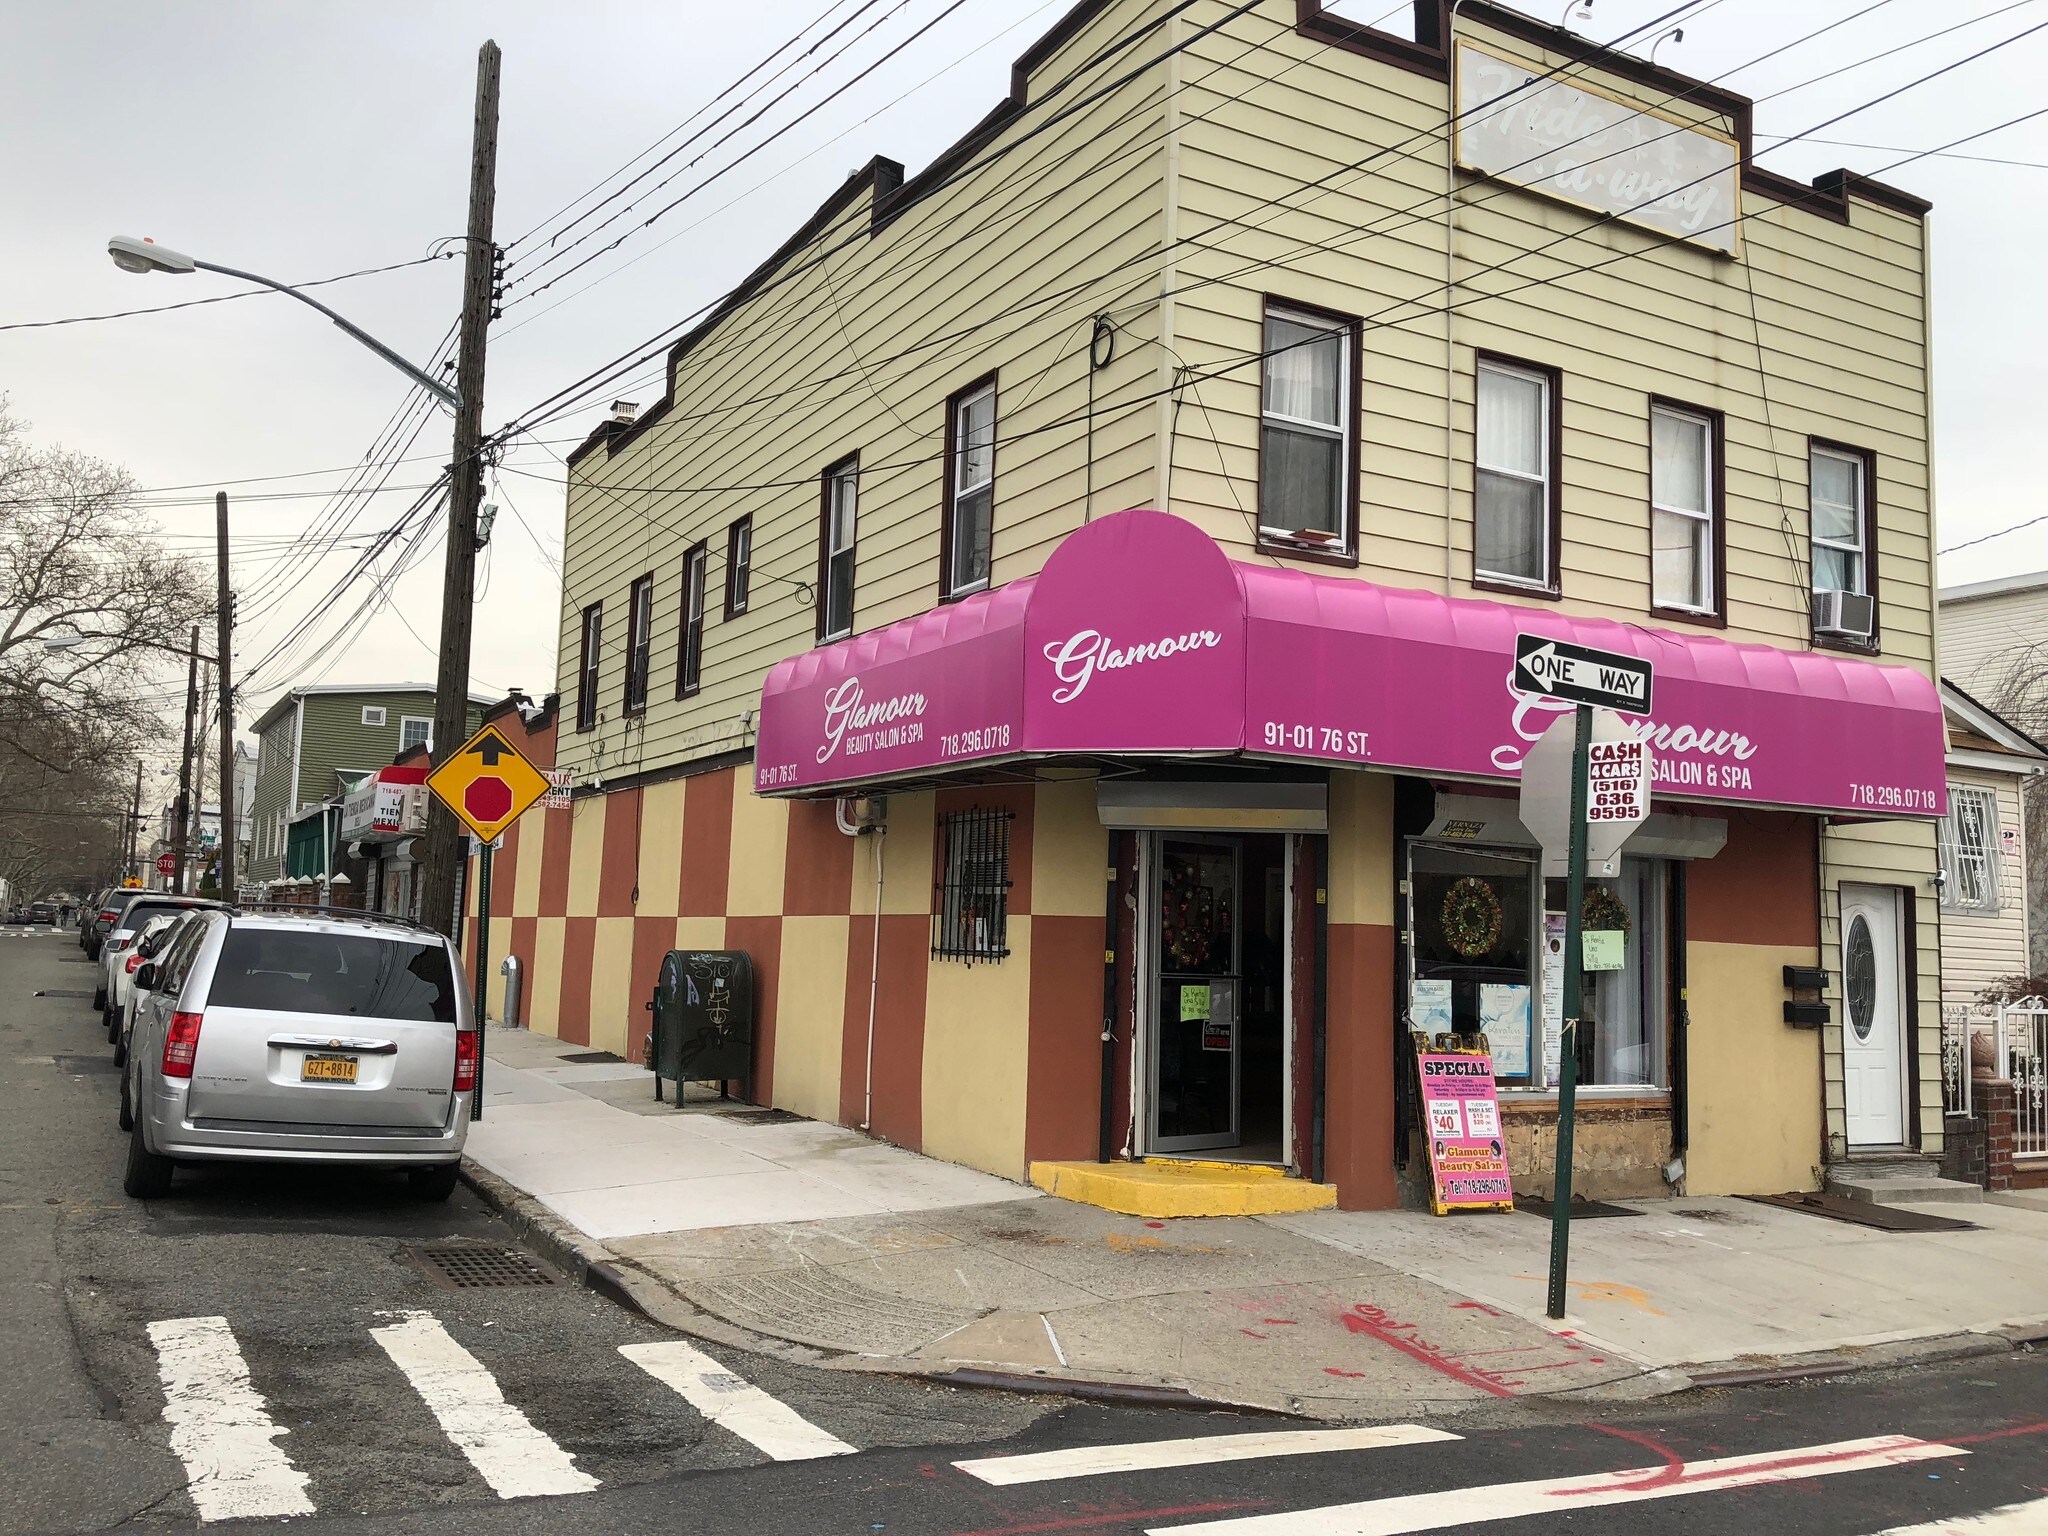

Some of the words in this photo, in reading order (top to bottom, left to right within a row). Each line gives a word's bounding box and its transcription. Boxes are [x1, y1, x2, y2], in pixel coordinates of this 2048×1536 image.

[1043, 629, 1222, 704] Glamour
[1531, 654, 1576, 683] ONE
[1599, 667, 1641, 695] WAY
[815, 676, 929, 764] Glamour
[846, 734, 874, 756] BEAUTY
[874, 727, 900, 750] SALON
[900, 727, 907, 745] &
[908, 722, 924, 743] SPA
[940, 724, 1011, 757] 718.296.0718
[1264, 722, 1313, 749] 91-01
[1320, 727, 1343, 752] 76
[1347, 731, 1372, 756] ST.
[1590, 742, 1642, 762] CA$H
[760, 765, 778, 786] 91-01
[778, 765, 788, 784] 76
[788, 763, 798, 782] ST.
[1591, 765, 1600, 779] 4
[1601, 762, 1640, 778] CAR$
[1650, 759, 1702, 785] SALON
[1706, 764, 1718, 787] &
[1721, 765, 1752, 790] SPA
[1592, 778, 1638, 793] (516)
[1595, 792, 1635, 806] 636
[1849, 784, 1937, 809] 718.296.0718
[1589, 806, 1640, 820] 9595
[157, 859, 175, 869] STO
[308, 1061, 325, 1075] GZT
[330, 1062, 354, 1077] 8814
[1424, 1061, 1490, 1076] SPECIAL
[1433, 1115, 1454, 1130] $40
[1447, 1146, 1490, 1158] Glamour
[1438, 1160, 1474, 1173] Beauty
[1463, 1178, 1508, 1194] 718-296-0718
